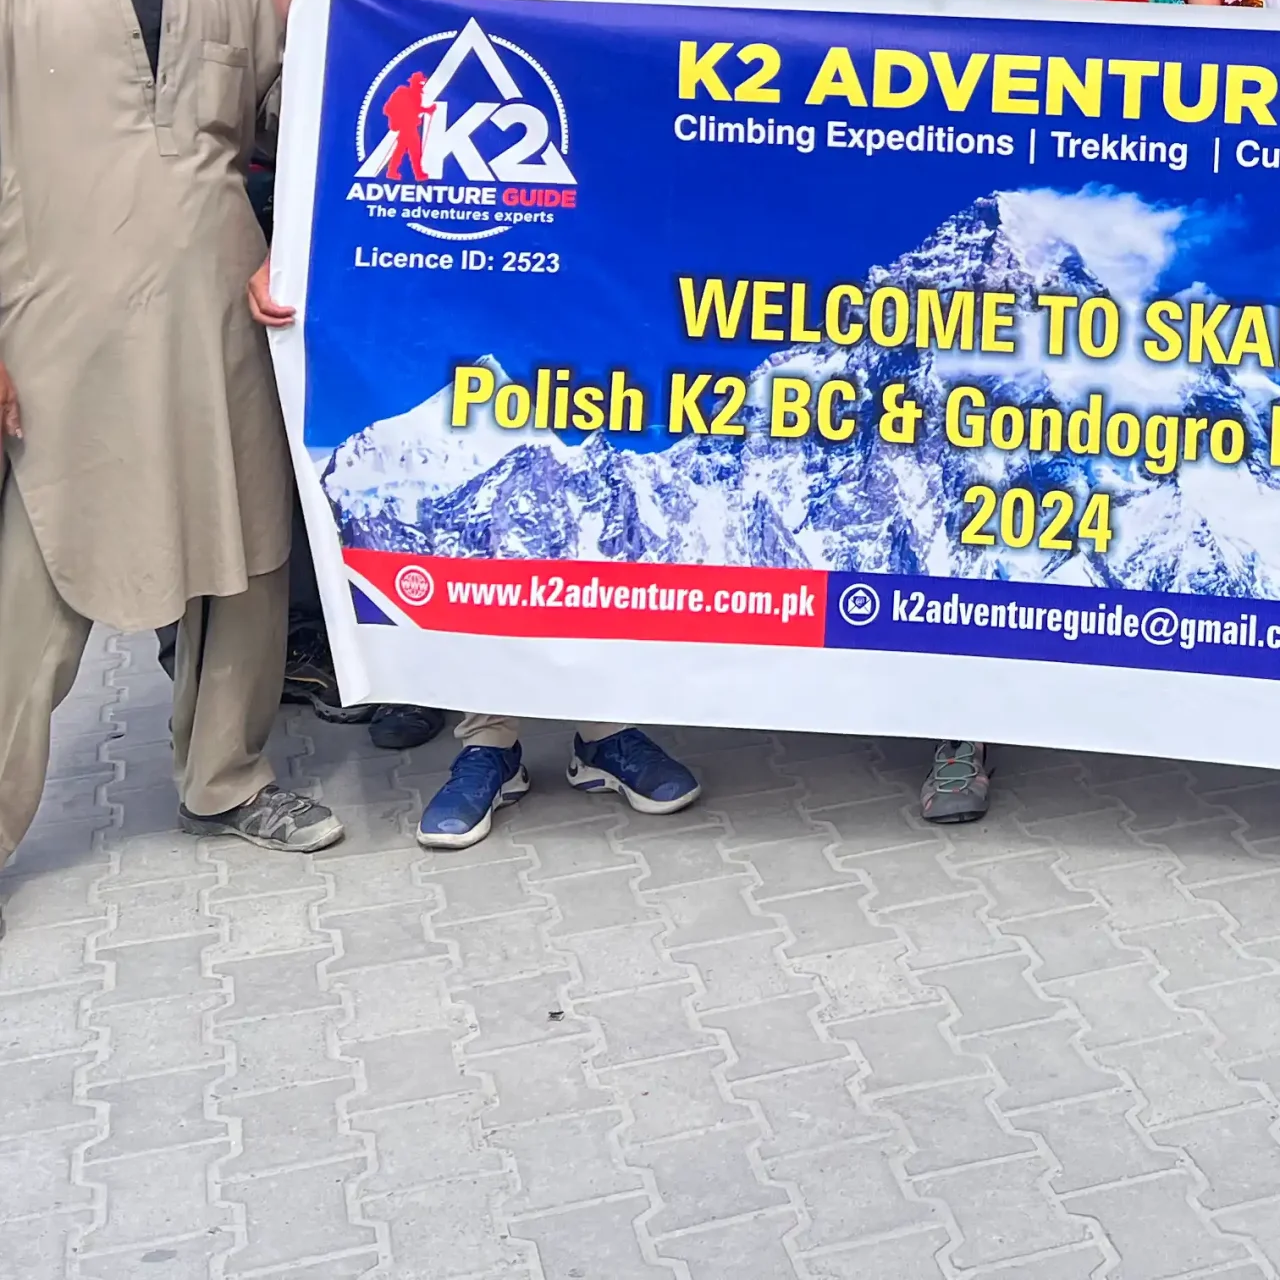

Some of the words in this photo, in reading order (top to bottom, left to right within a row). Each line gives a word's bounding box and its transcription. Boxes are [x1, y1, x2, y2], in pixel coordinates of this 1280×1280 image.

[679, 41, 781, 102] K2
[673, 113, 816, 154] Climbing
[826, 120, 1015, 157] Expeditions
[1050, 130, 1189, 172] Trekking
[345, 181, 498, 206] ADVENTURE
[502, 187, 577, 208] GUIDE
[366, 204, 397, 219] The
[400, 204, 490, 222] adventures
[493, 208, 555, 224] experts
[355, 246, 453, 269] Licence
[461, 250, 494, 271] ID:
[501, 251, 561, 273] 2523
[680, 278, 1015, 352] WELCOME
[1038, 294, 1120, 358] TO
[452, 367, 645, 430] Polish
[669, 374, 747, 435] K2
[771, 377, 857, 440] BC
[880, 382, 924, 443] &
[946, 386, 1246, 474] Gondogro
[961, 485, 1113, 551] 2024
[445, 574, 816, 624] www.k2adventure.com.pk
